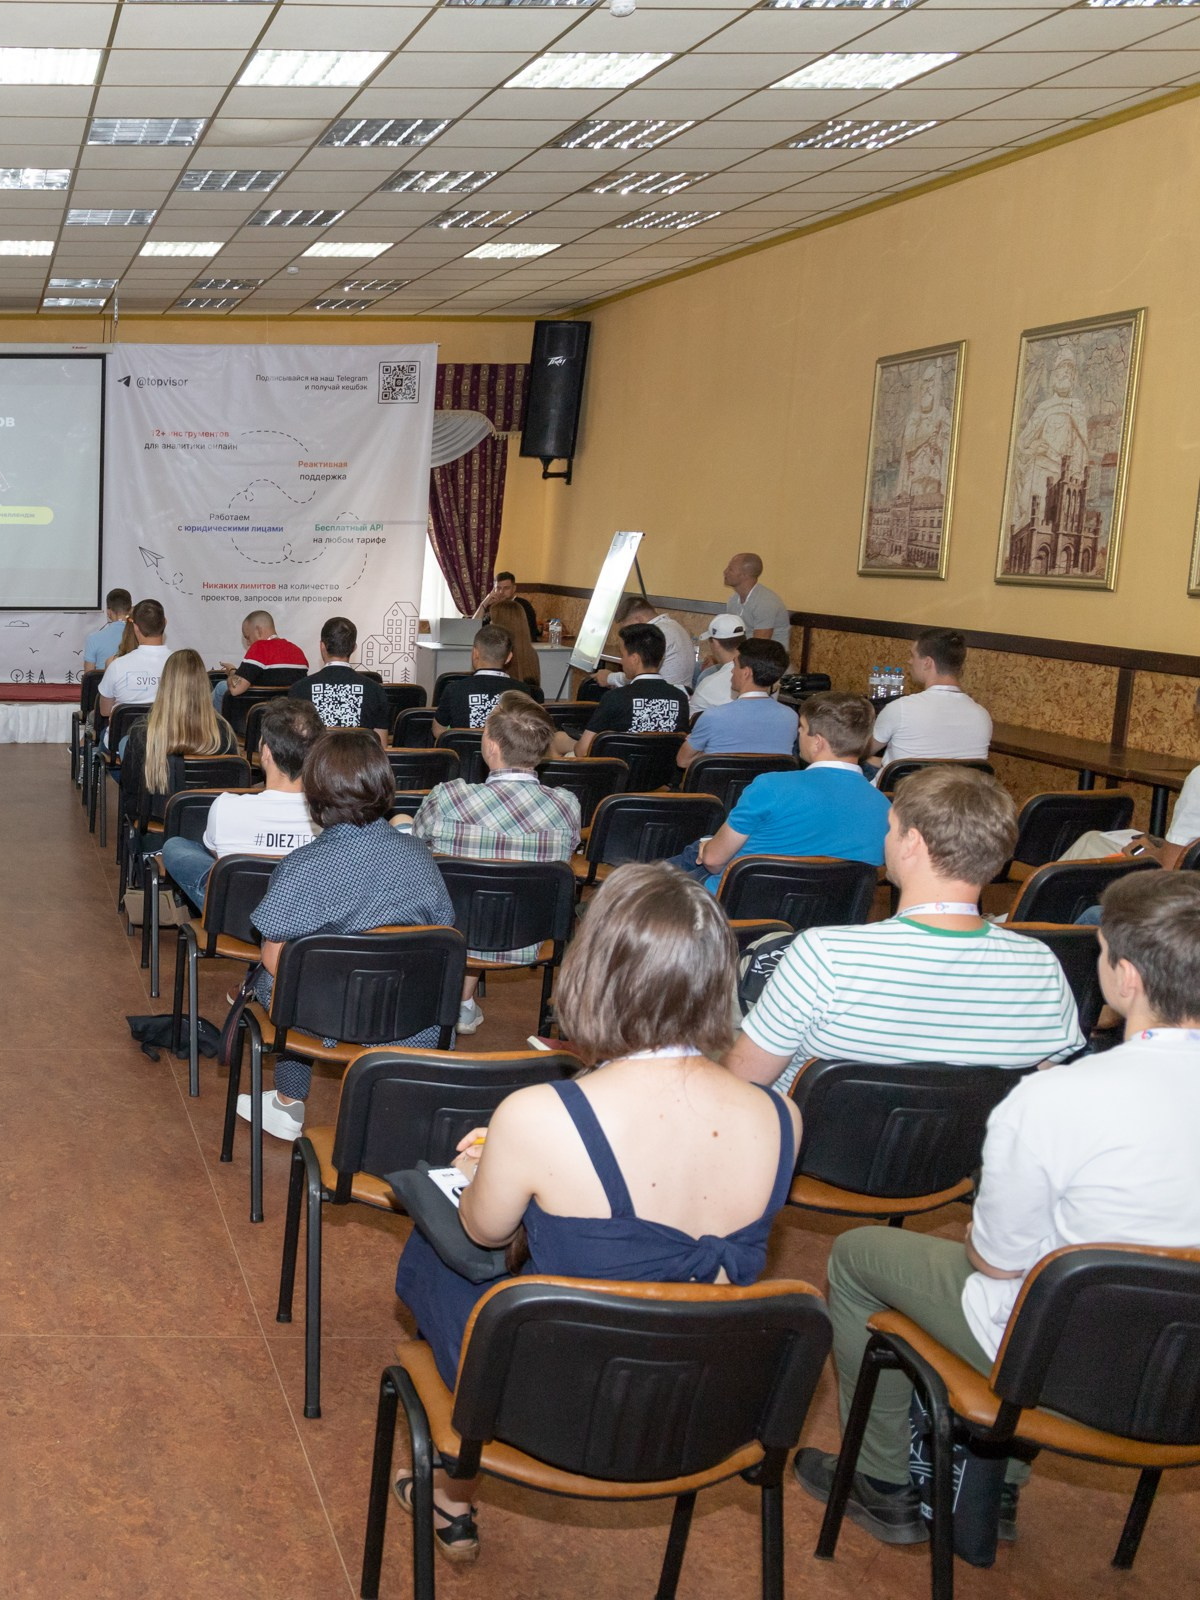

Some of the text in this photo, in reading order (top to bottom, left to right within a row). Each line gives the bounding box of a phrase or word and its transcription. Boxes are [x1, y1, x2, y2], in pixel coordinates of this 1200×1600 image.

[136, 377, 189, 388] @topvisor
[337, 374, 368, 383] Telegram
[311, 383, 340, 391] получай
[144, 442, 158, 450] для
[207, 442, 238, 450] онлайн
[298, 460, 348, 468] Реактивная
[299, 474, 347, 482] поддержка
[209, 513, 250, 521] Работаем
[184, 525, 249, 533] юридическими
[314, 524, 384, 532] Бесплатный API
[324, 536, 353, 544] любом
[356, 537, 387, 545] тарифе
[202, 582, 238, 590] Никаких
[200, 594, 242, 603] проектов,
[244, 595, 283, 603] запросов
[302, 595, 342, 604] проверок
